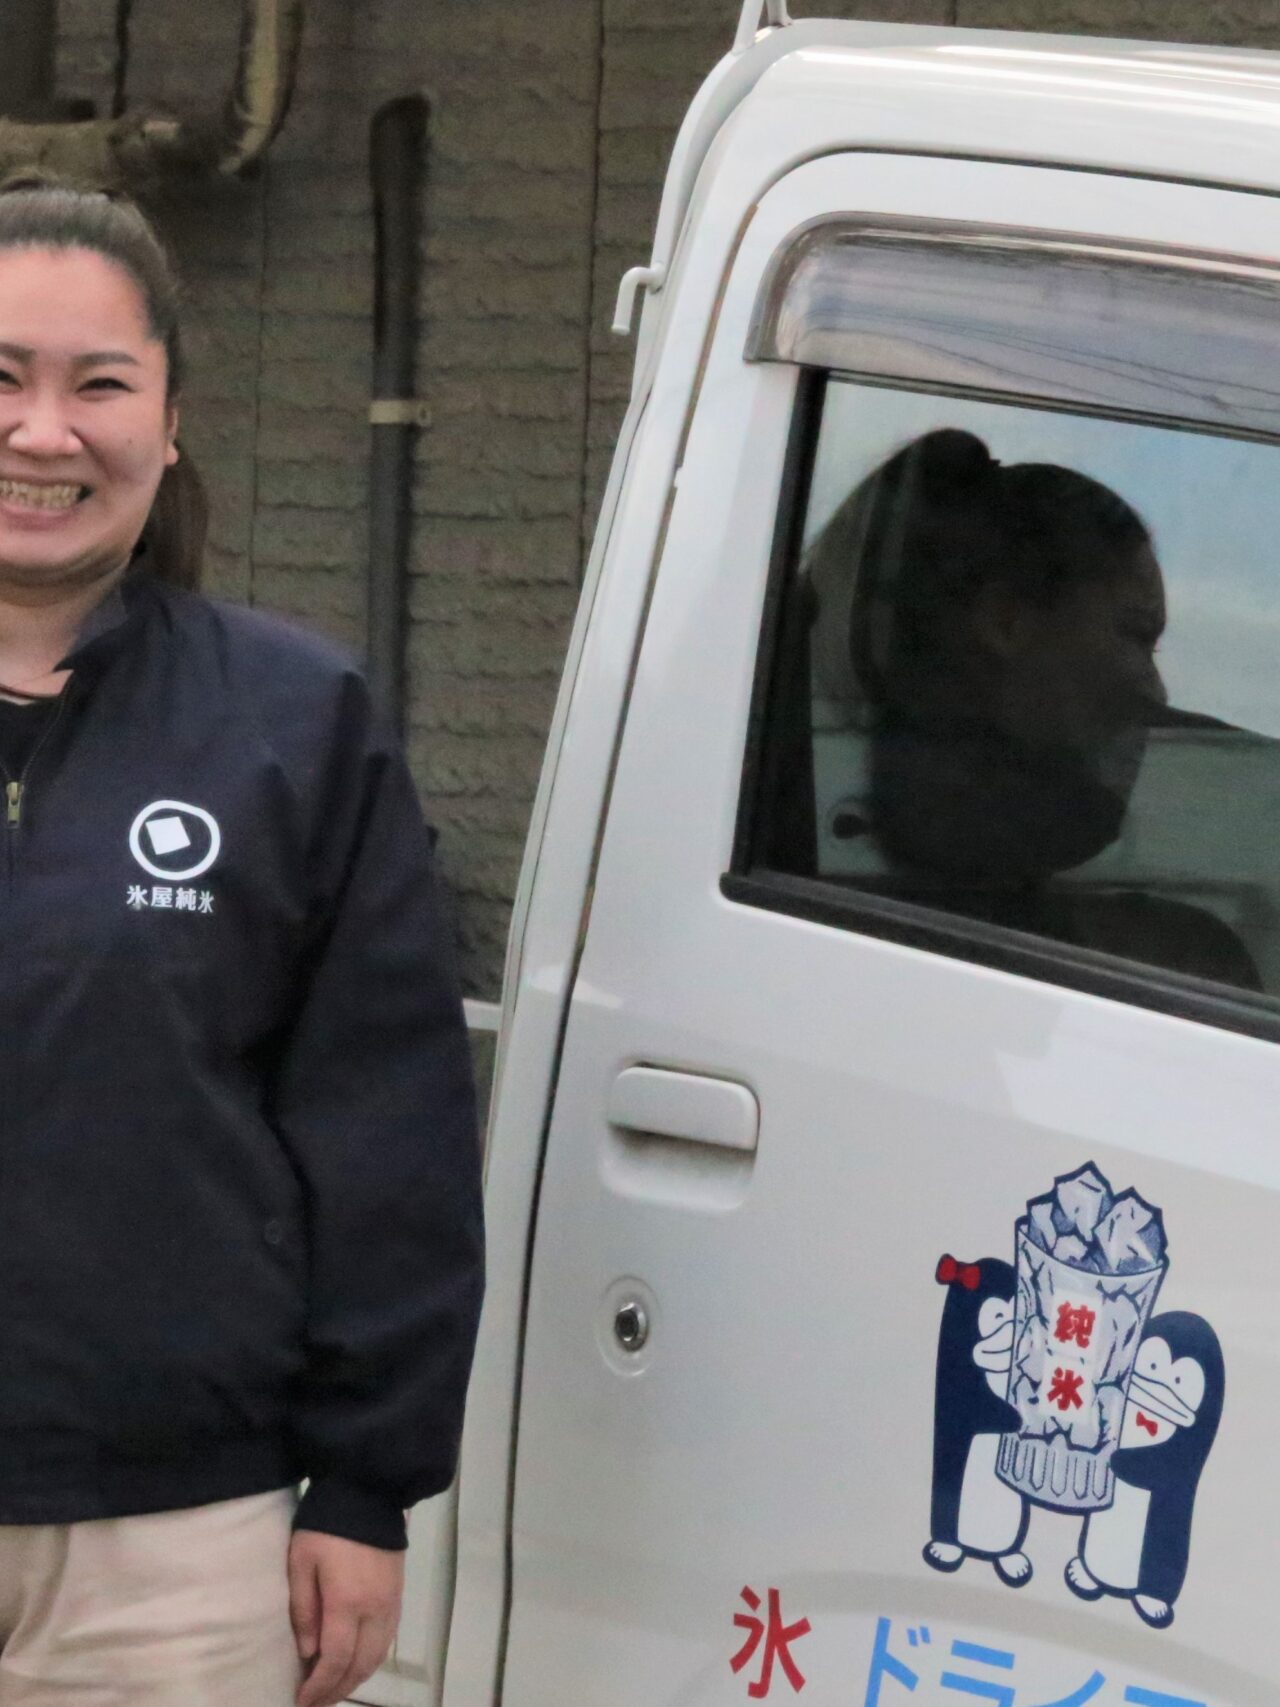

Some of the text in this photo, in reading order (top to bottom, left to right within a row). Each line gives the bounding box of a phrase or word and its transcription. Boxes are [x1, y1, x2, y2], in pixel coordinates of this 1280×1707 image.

[126, 884, 215, 914] 氷屋純氷
[1047, 1301, 1096, 1411] 純氷
[729, 1585, 1208, 1707] 氷 ドラ
